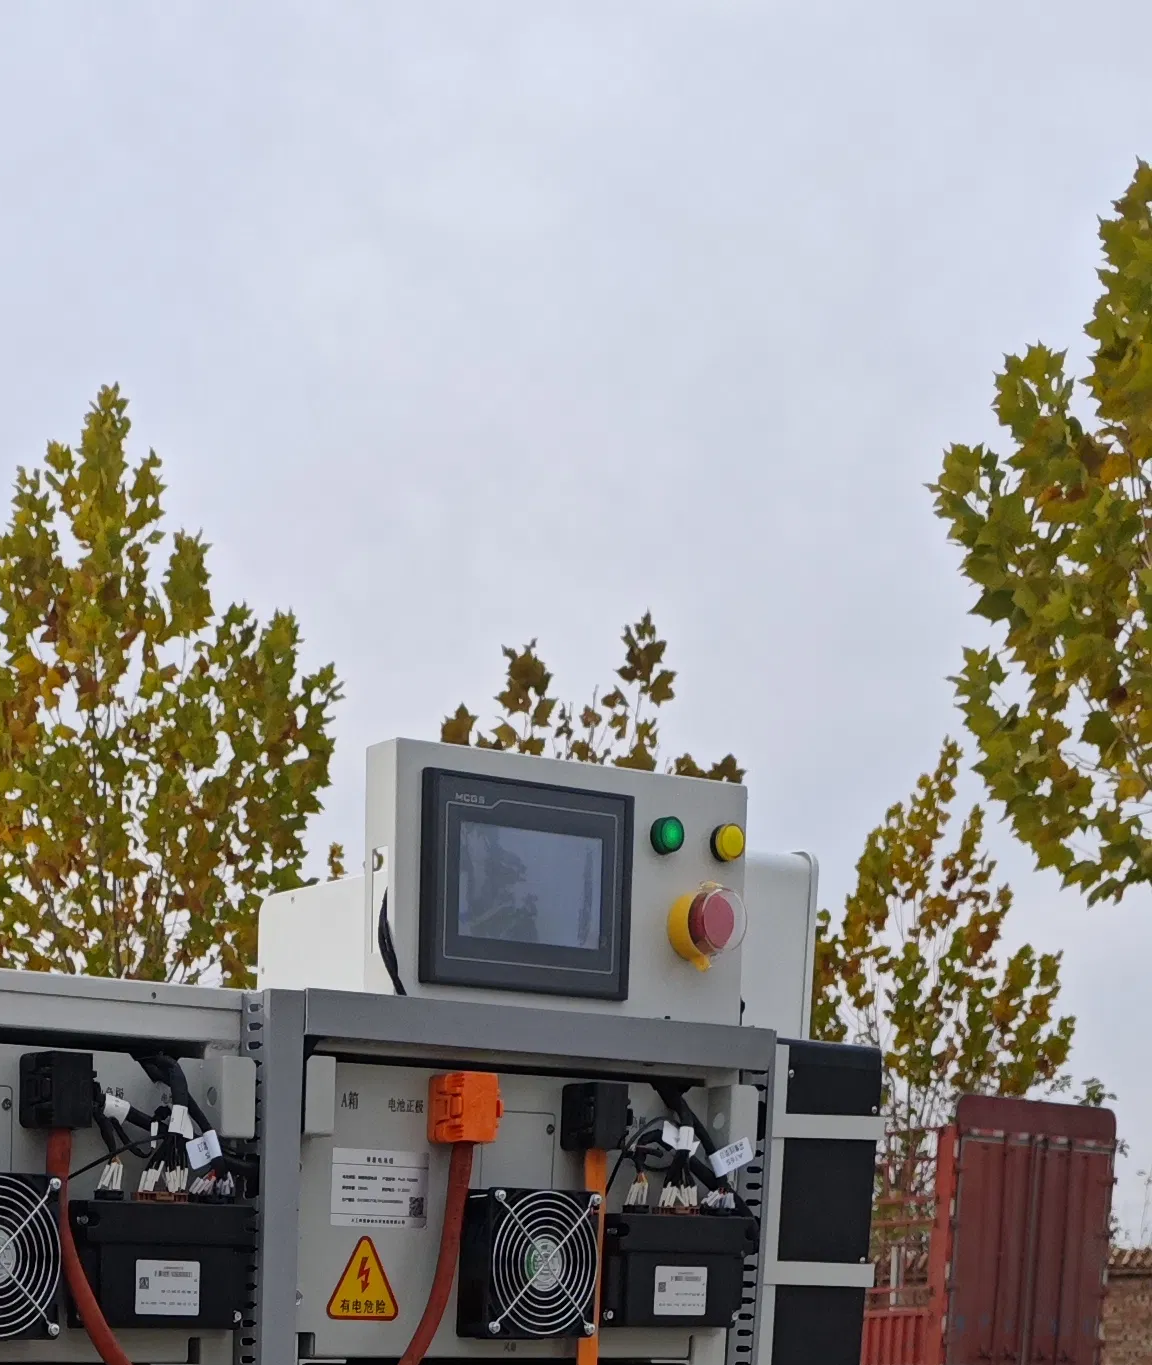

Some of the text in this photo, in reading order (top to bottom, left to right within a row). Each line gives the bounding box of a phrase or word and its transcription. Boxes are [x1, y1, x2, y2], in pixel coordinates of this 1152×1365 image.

[455, 793, 485, 804] MCGS
[341, 1091, 358, 1110] A箱
[389, 1098, 423, 1113] 电池正极
[340, 1299, 386, 1314] 有电危险
